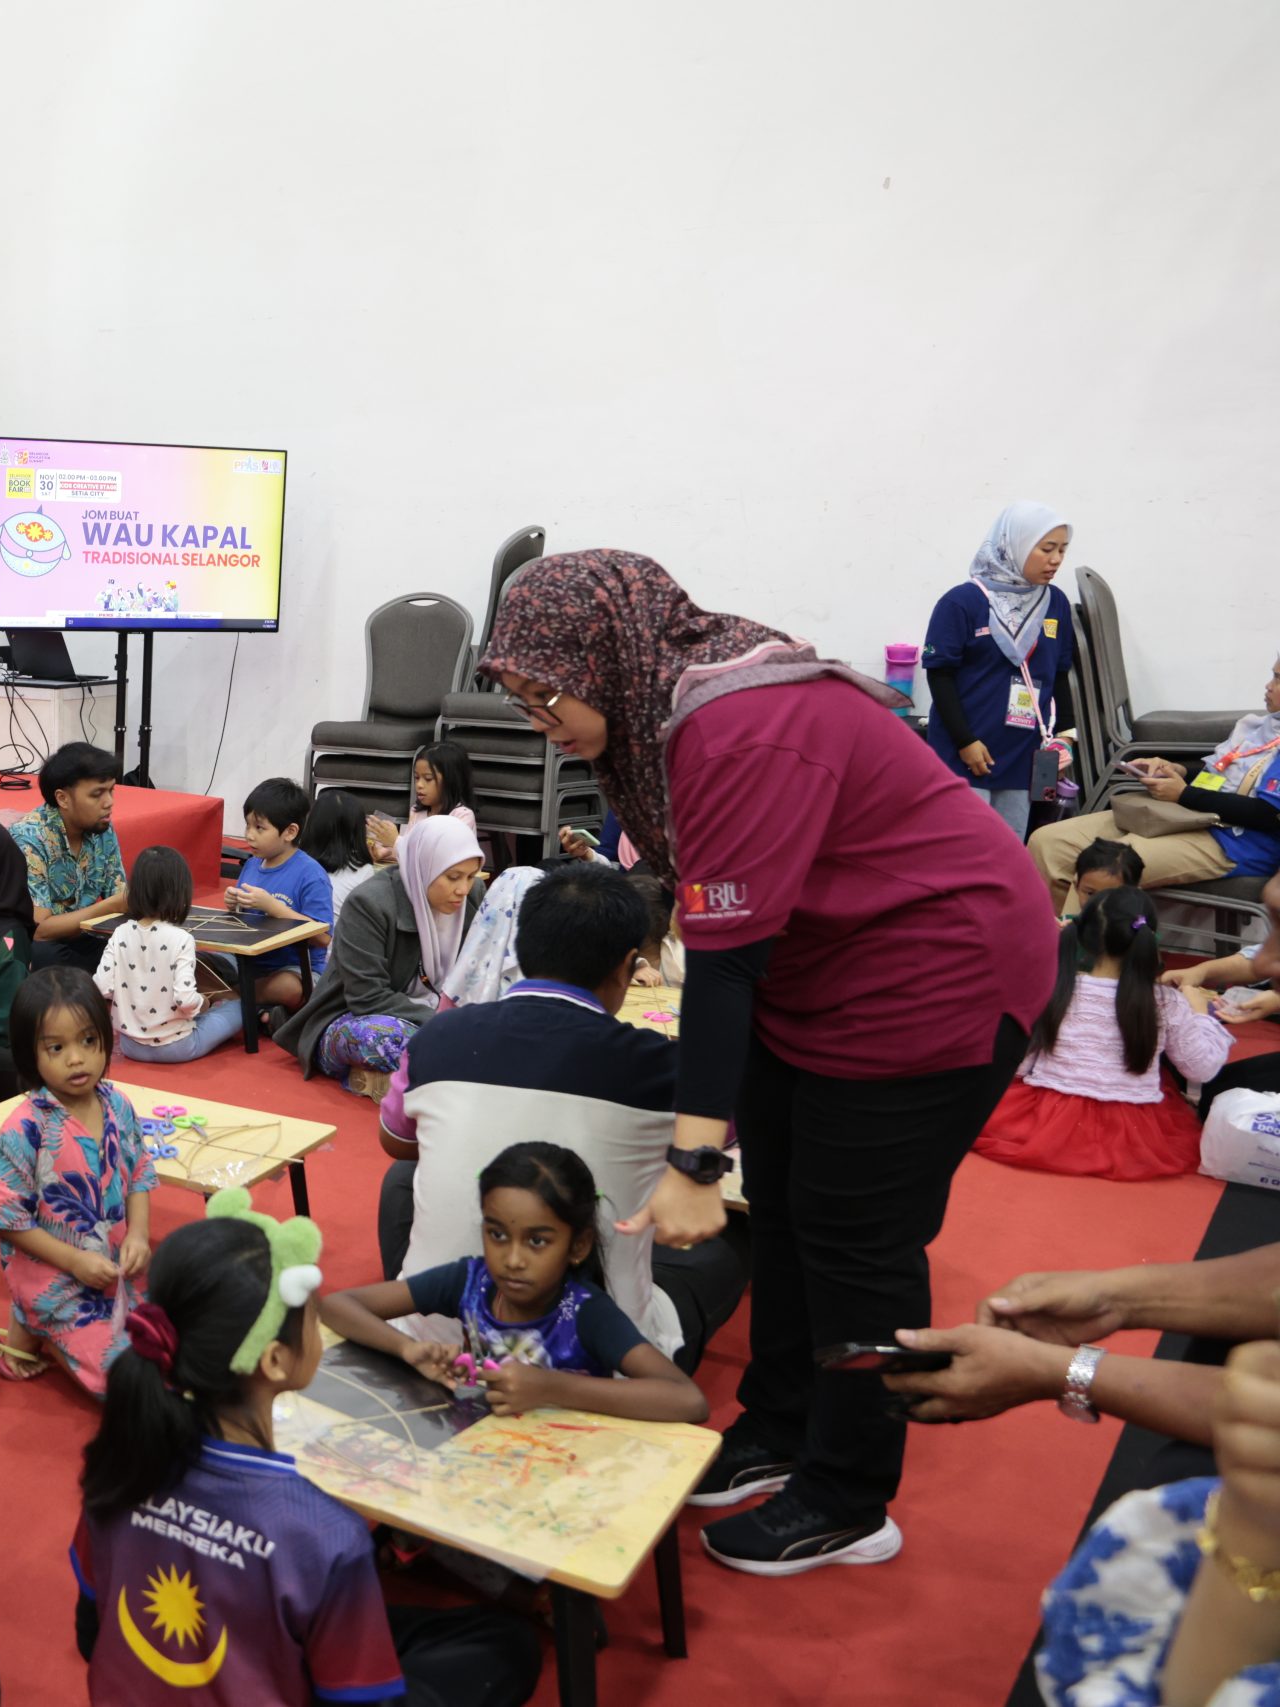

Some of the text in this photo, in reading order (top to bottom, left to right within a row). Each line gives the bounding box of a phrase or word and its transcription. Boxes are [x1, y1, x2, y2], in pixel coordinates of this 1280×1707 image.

[39, 481, 54, 491] 30
[81, 509, 140, 521] JOM BUAT
[82, 522, 252, 550] WAU KAPAL
[82, 551, 261, 568] TRADISIONAL SELANGOR
[703, 881, 747, 911] RJU
[130, 1510, 246, 1570] MERDEKA
